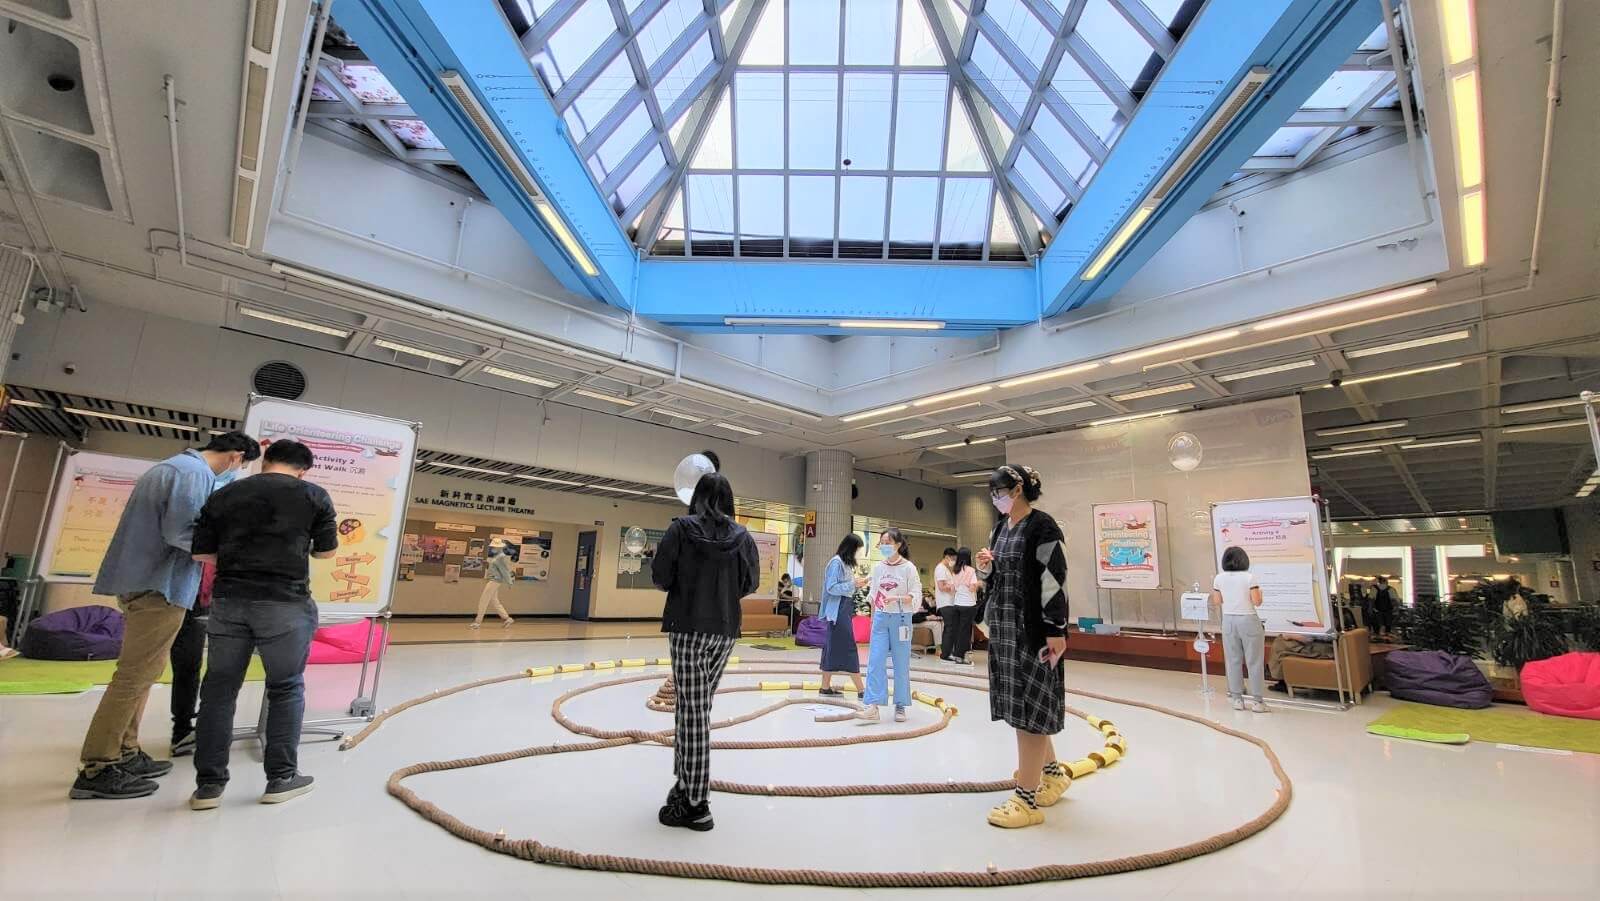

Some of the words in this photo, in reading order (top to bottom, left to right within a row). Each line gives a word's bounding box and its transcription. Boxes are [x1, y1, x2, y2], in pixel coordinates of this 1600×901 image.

[263, 421, 285, 433] Life
[312, 454, 347, 465] Activity
[324, 464, 347, 472] Walk
[415, 496, 429, 504] SAE
[431, 498, 474, 509] MAGNETICS
[476, 503, 505, 512] LECTURE
[507, 506, 535, 515] THEATRE
[1101, 517, 1124, 529] Life
[807, 526, 814, 536] A
